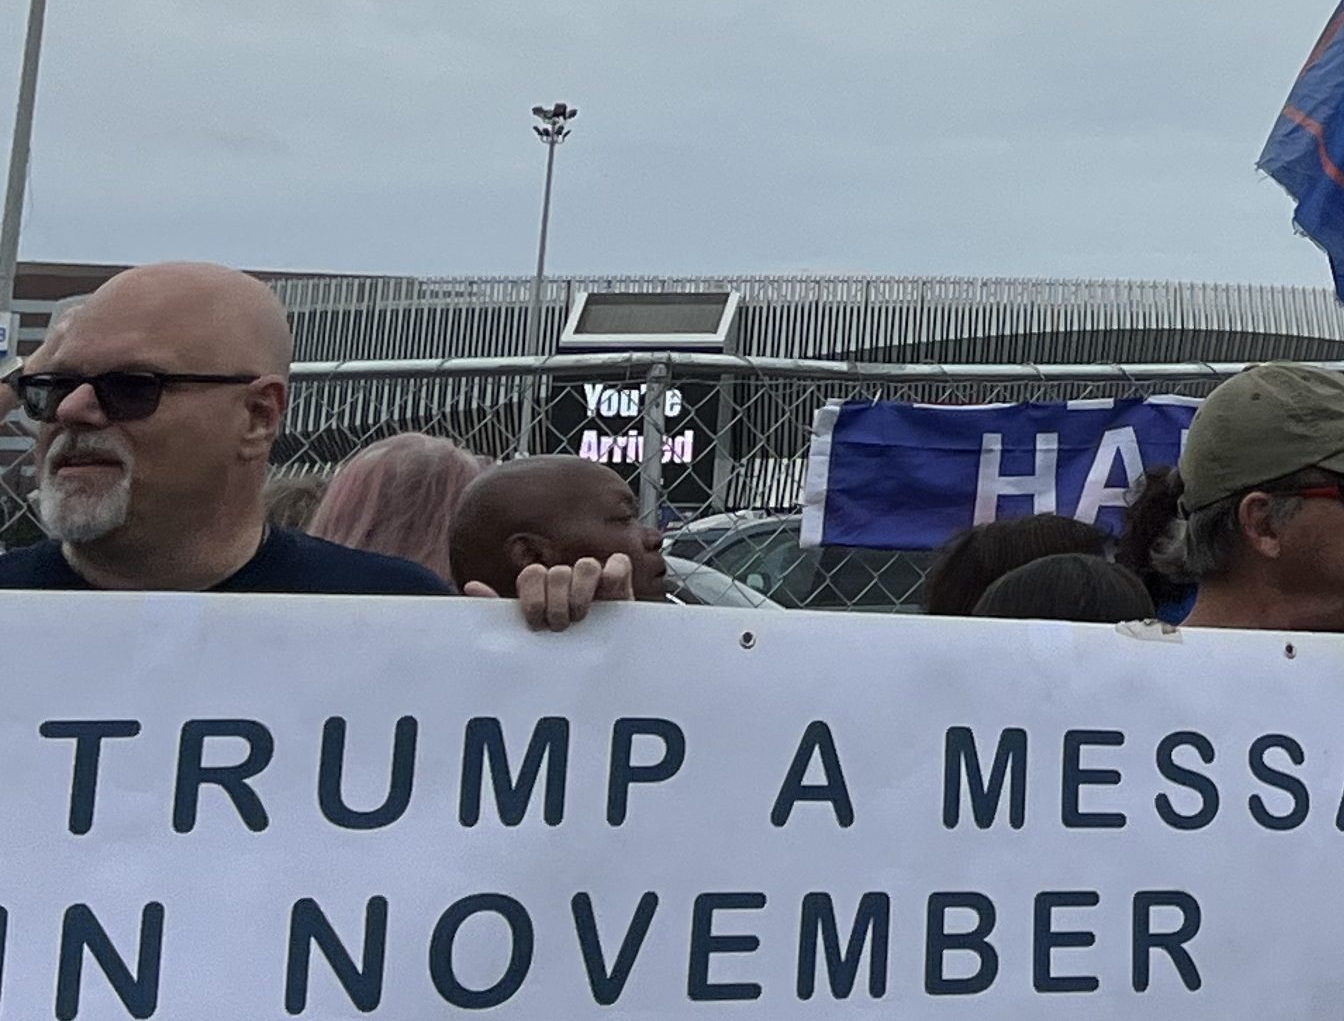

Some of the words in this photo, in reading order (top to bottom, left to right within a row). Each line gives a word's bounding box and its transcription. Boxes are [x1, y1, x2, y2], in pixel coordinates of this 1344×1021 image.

[583, 383, 682, 417] You'e
[579, 429, 695, 463] Arried
[38, 715, 687, 835] TRUMP
[769, 719, 855, 828] A
[284, 888, 1203, 1015] NOVEMBER
